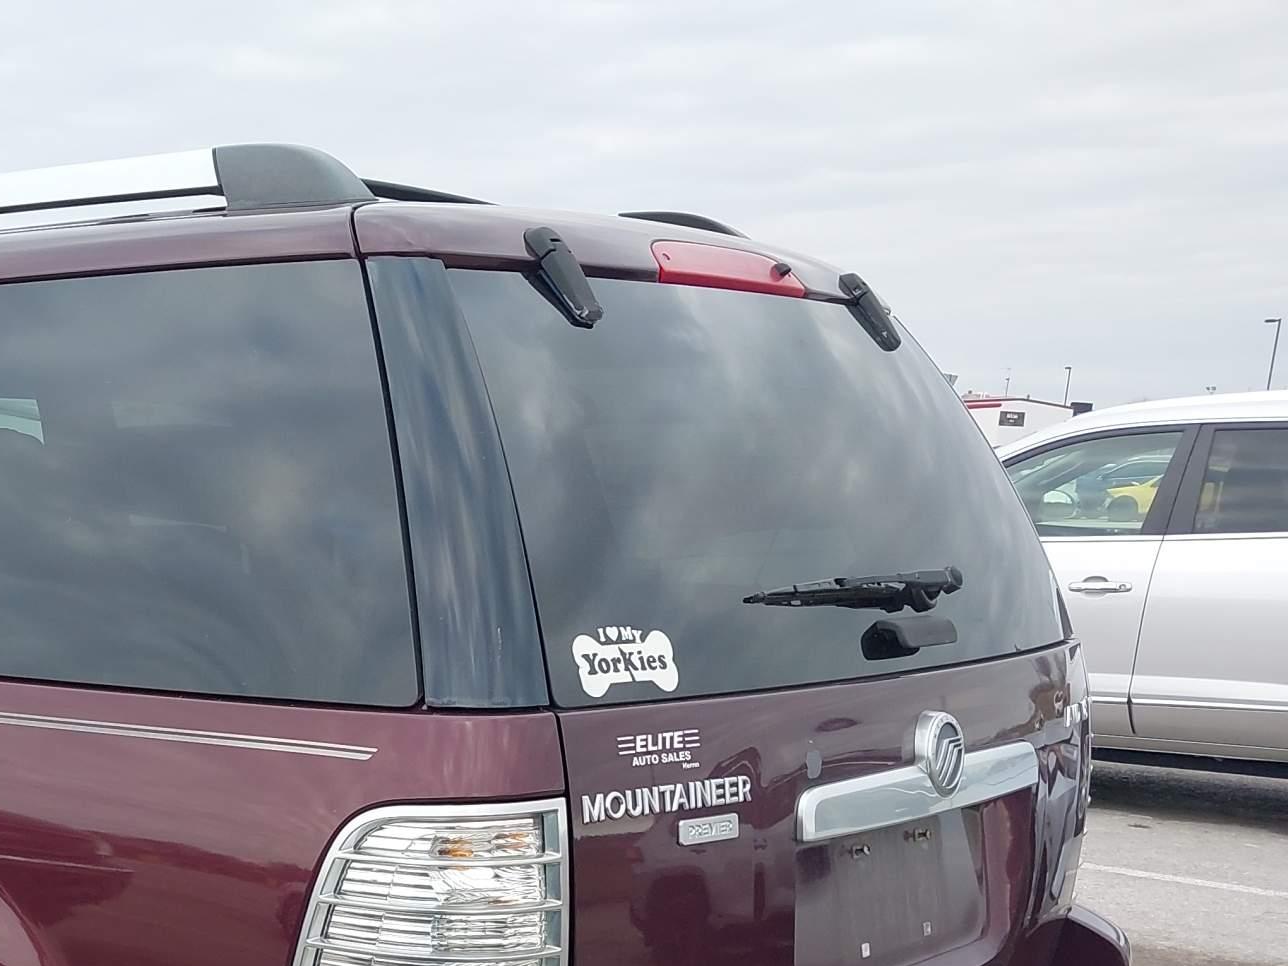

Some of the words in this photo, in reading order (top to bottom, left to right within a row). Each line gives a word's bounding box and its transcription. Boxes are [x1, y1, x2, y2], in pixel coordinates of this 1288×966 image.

[635, 730, 684, 753] ELITE
[632, 754, 660, 767] AUTO
[661, 750, 692, 763] SALES
[581, 775, 752, 824] MOUNTAINEER
